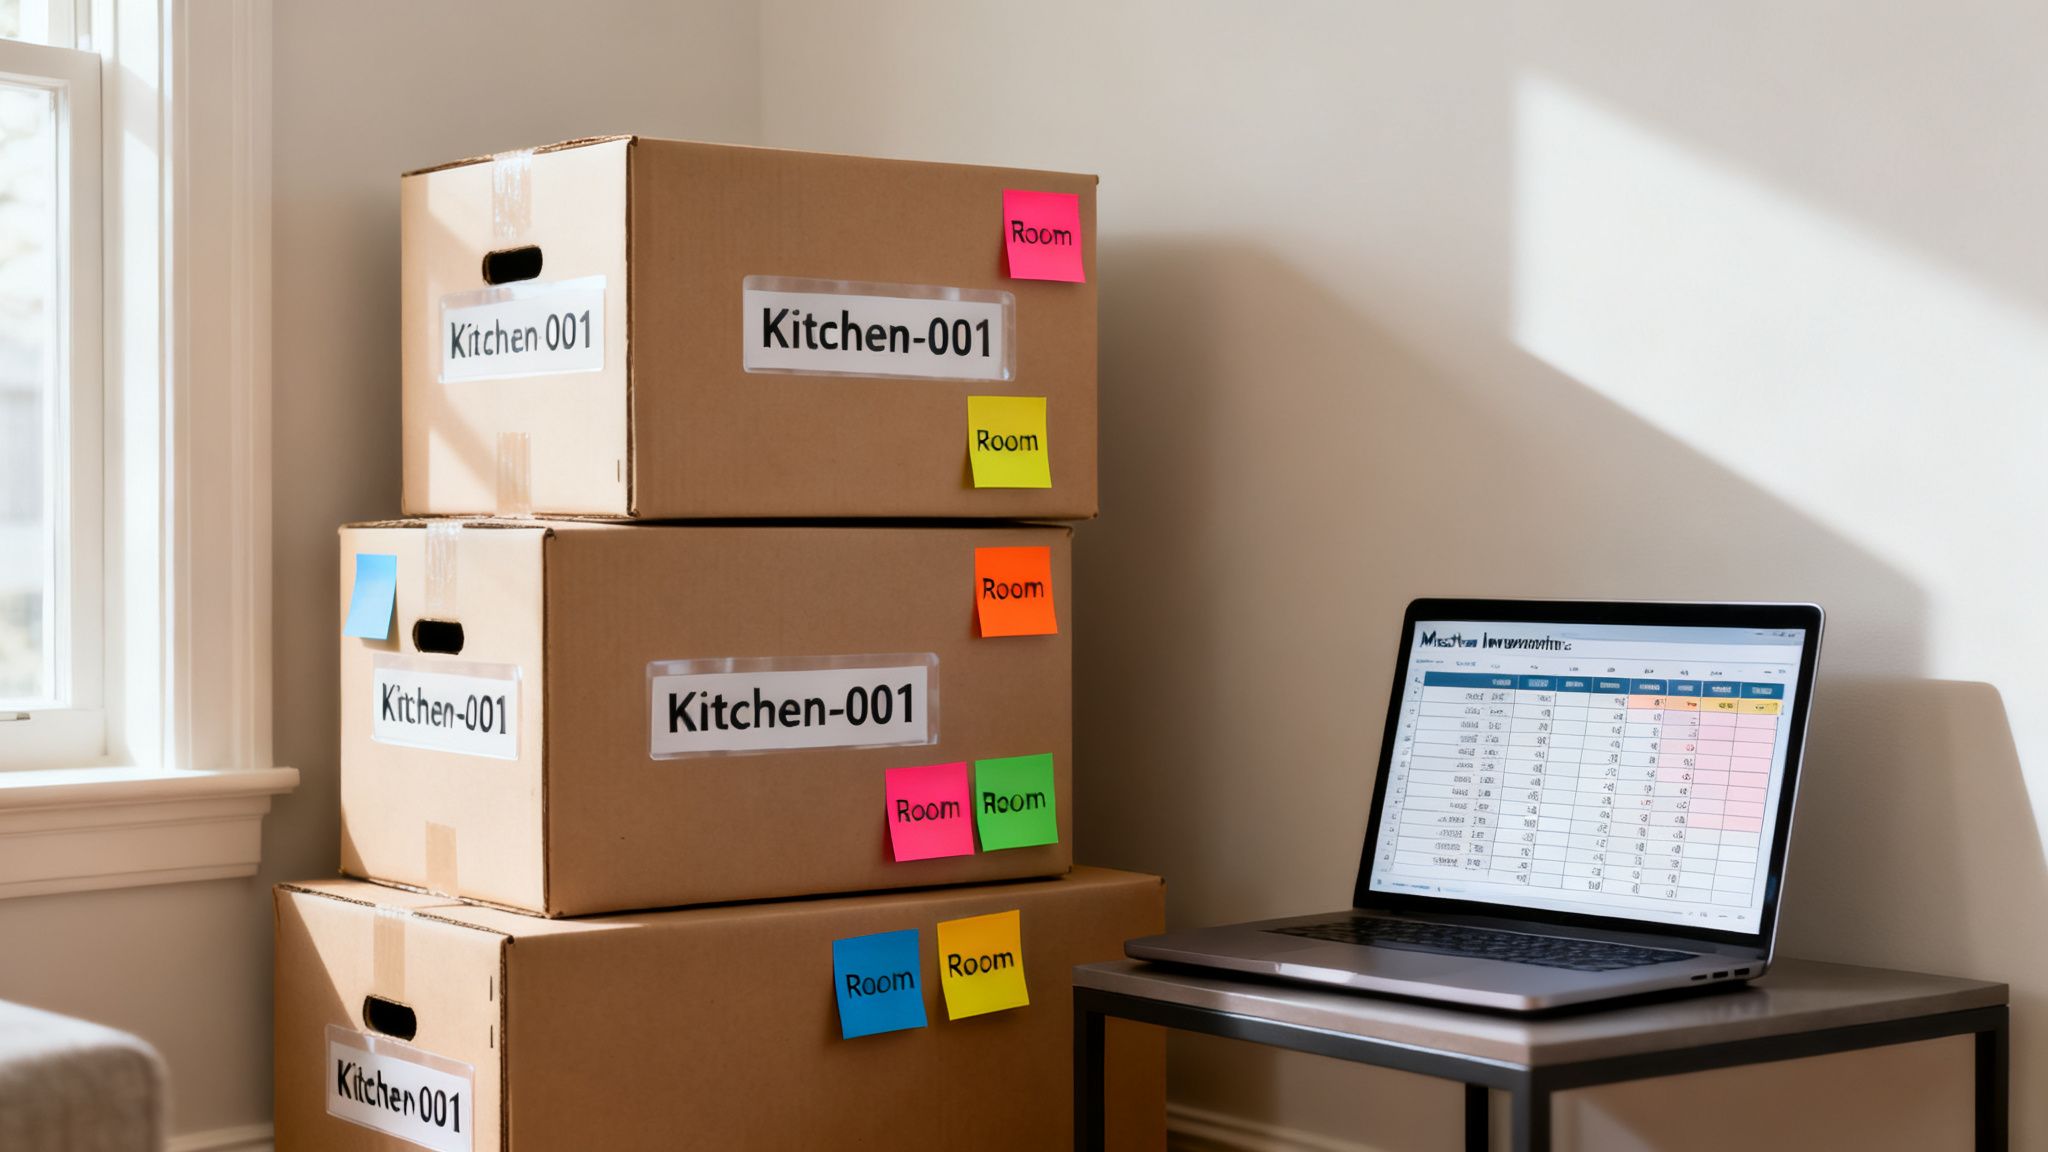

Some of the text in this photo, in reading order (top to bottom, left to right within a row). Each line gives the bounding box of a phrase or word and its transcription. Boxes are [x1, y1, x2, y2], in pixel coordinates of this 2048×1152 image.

[1011, 219, 1073, 246] Room
[762, 307, 991, 358] Kitchen-001
[976, 429, 1040, 452] Room
[982, 577, 1045, 600] Room
[668, 682, 914, 734] Kitchen-001
[895, 799, 961, 823] Room
[982, 790, 1047, 815] Room
[947, 951, 1015, 978] Room
[845, 970, 915, 999] Room
